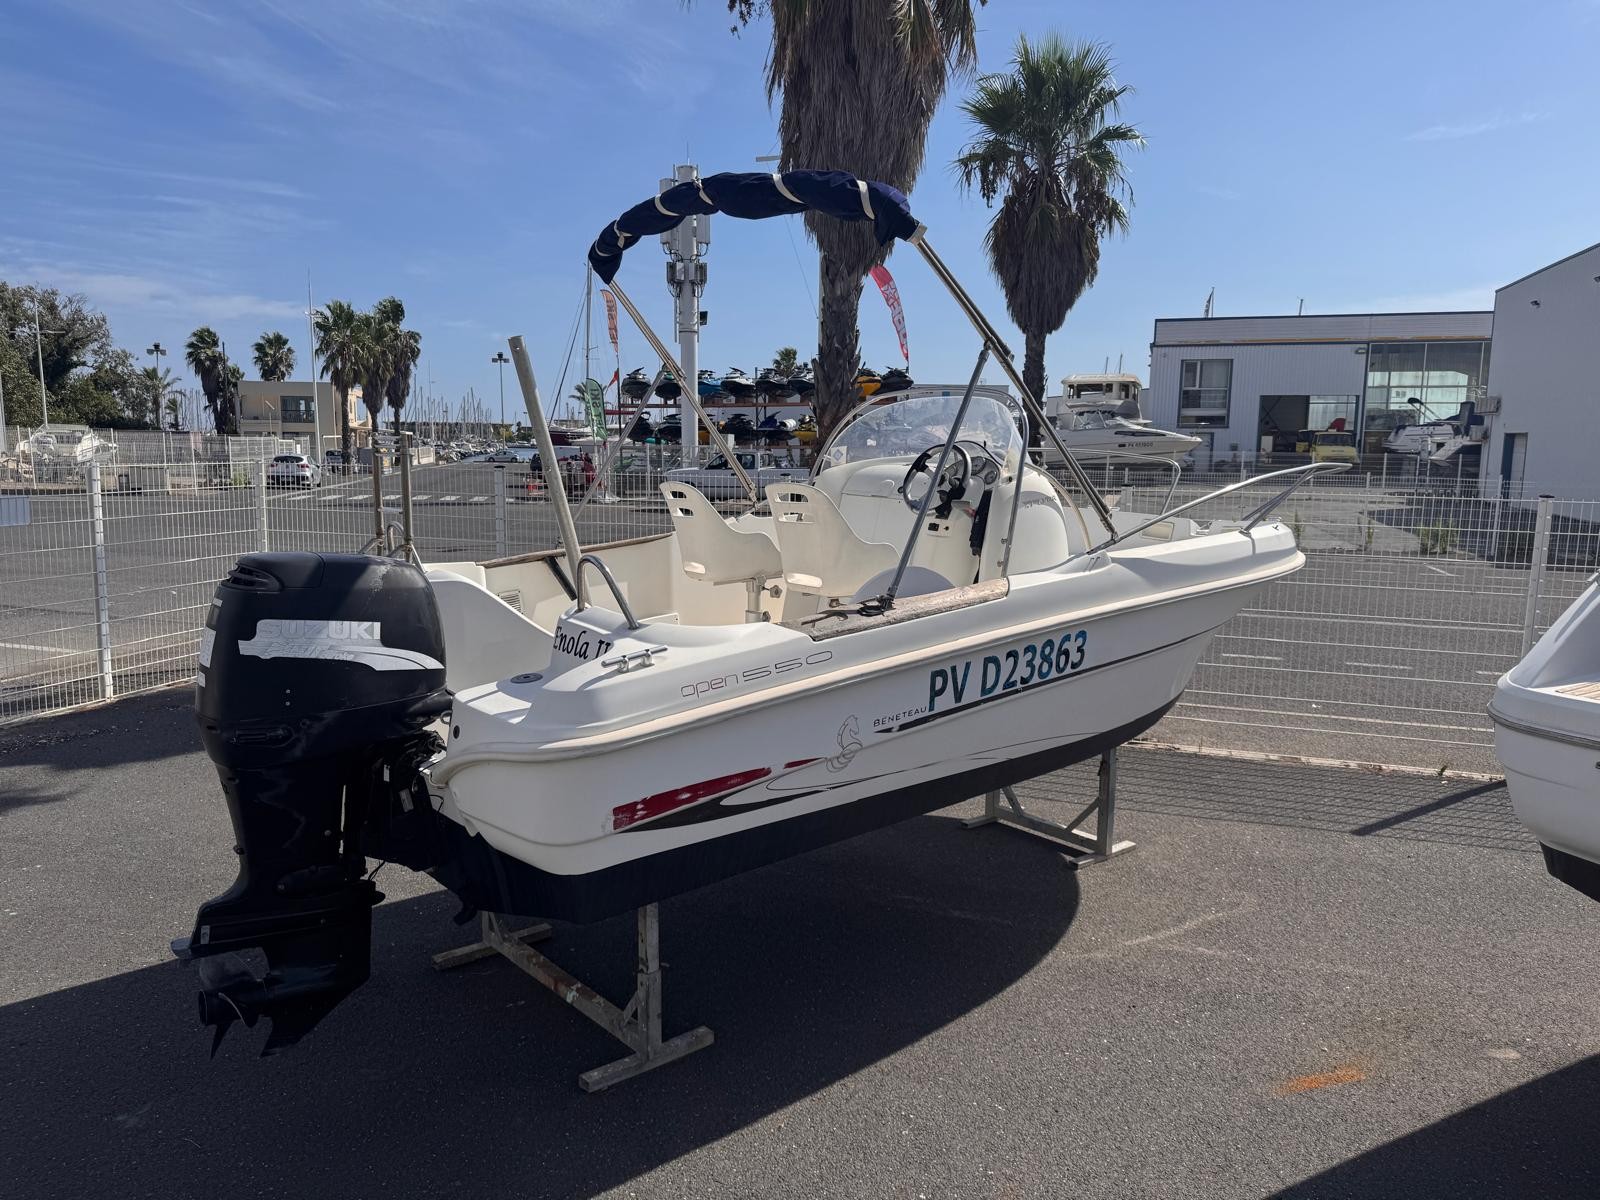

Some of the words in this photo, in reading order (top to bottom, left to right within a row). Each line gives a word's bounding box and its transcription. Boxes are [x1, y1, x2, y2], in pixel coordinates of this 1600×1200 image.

[258, 619, 381, 640] SUZUKI
[553, 626, 590, 660] Enola
[928, 661, 971, 712] PV
[980, 630, 1088, 697] D23863
[681, 674, 739, 698] open
[873, 706, 928, 727] BENETEAU
